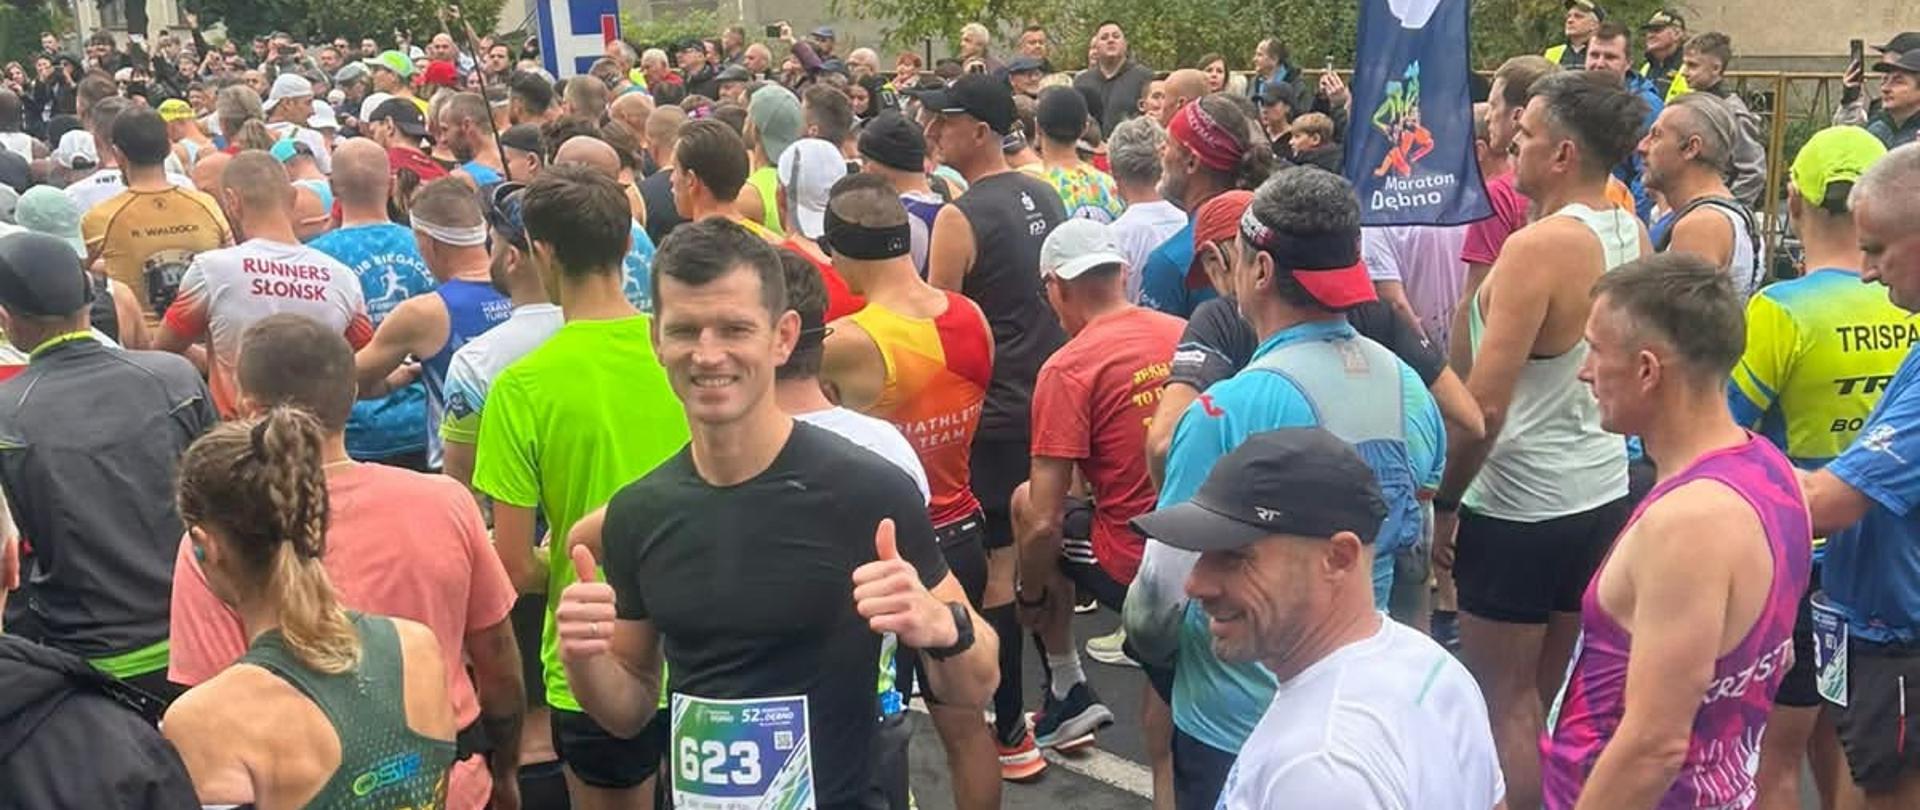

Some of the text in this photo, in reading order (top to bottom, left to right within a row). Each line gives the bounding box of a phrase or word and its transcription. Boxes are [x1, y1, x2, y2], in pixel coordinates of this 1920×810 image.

[1385, 173, 1455, 191] Maraton
[1371, 190, 1441, 211] Dębno
[243, 258, 331, 281] RUNNERS
[251, 277, 327, 302] SŁOŃSK
[920, 426, 966, 448] TEAM
[680, 736, 762, 785] 623
